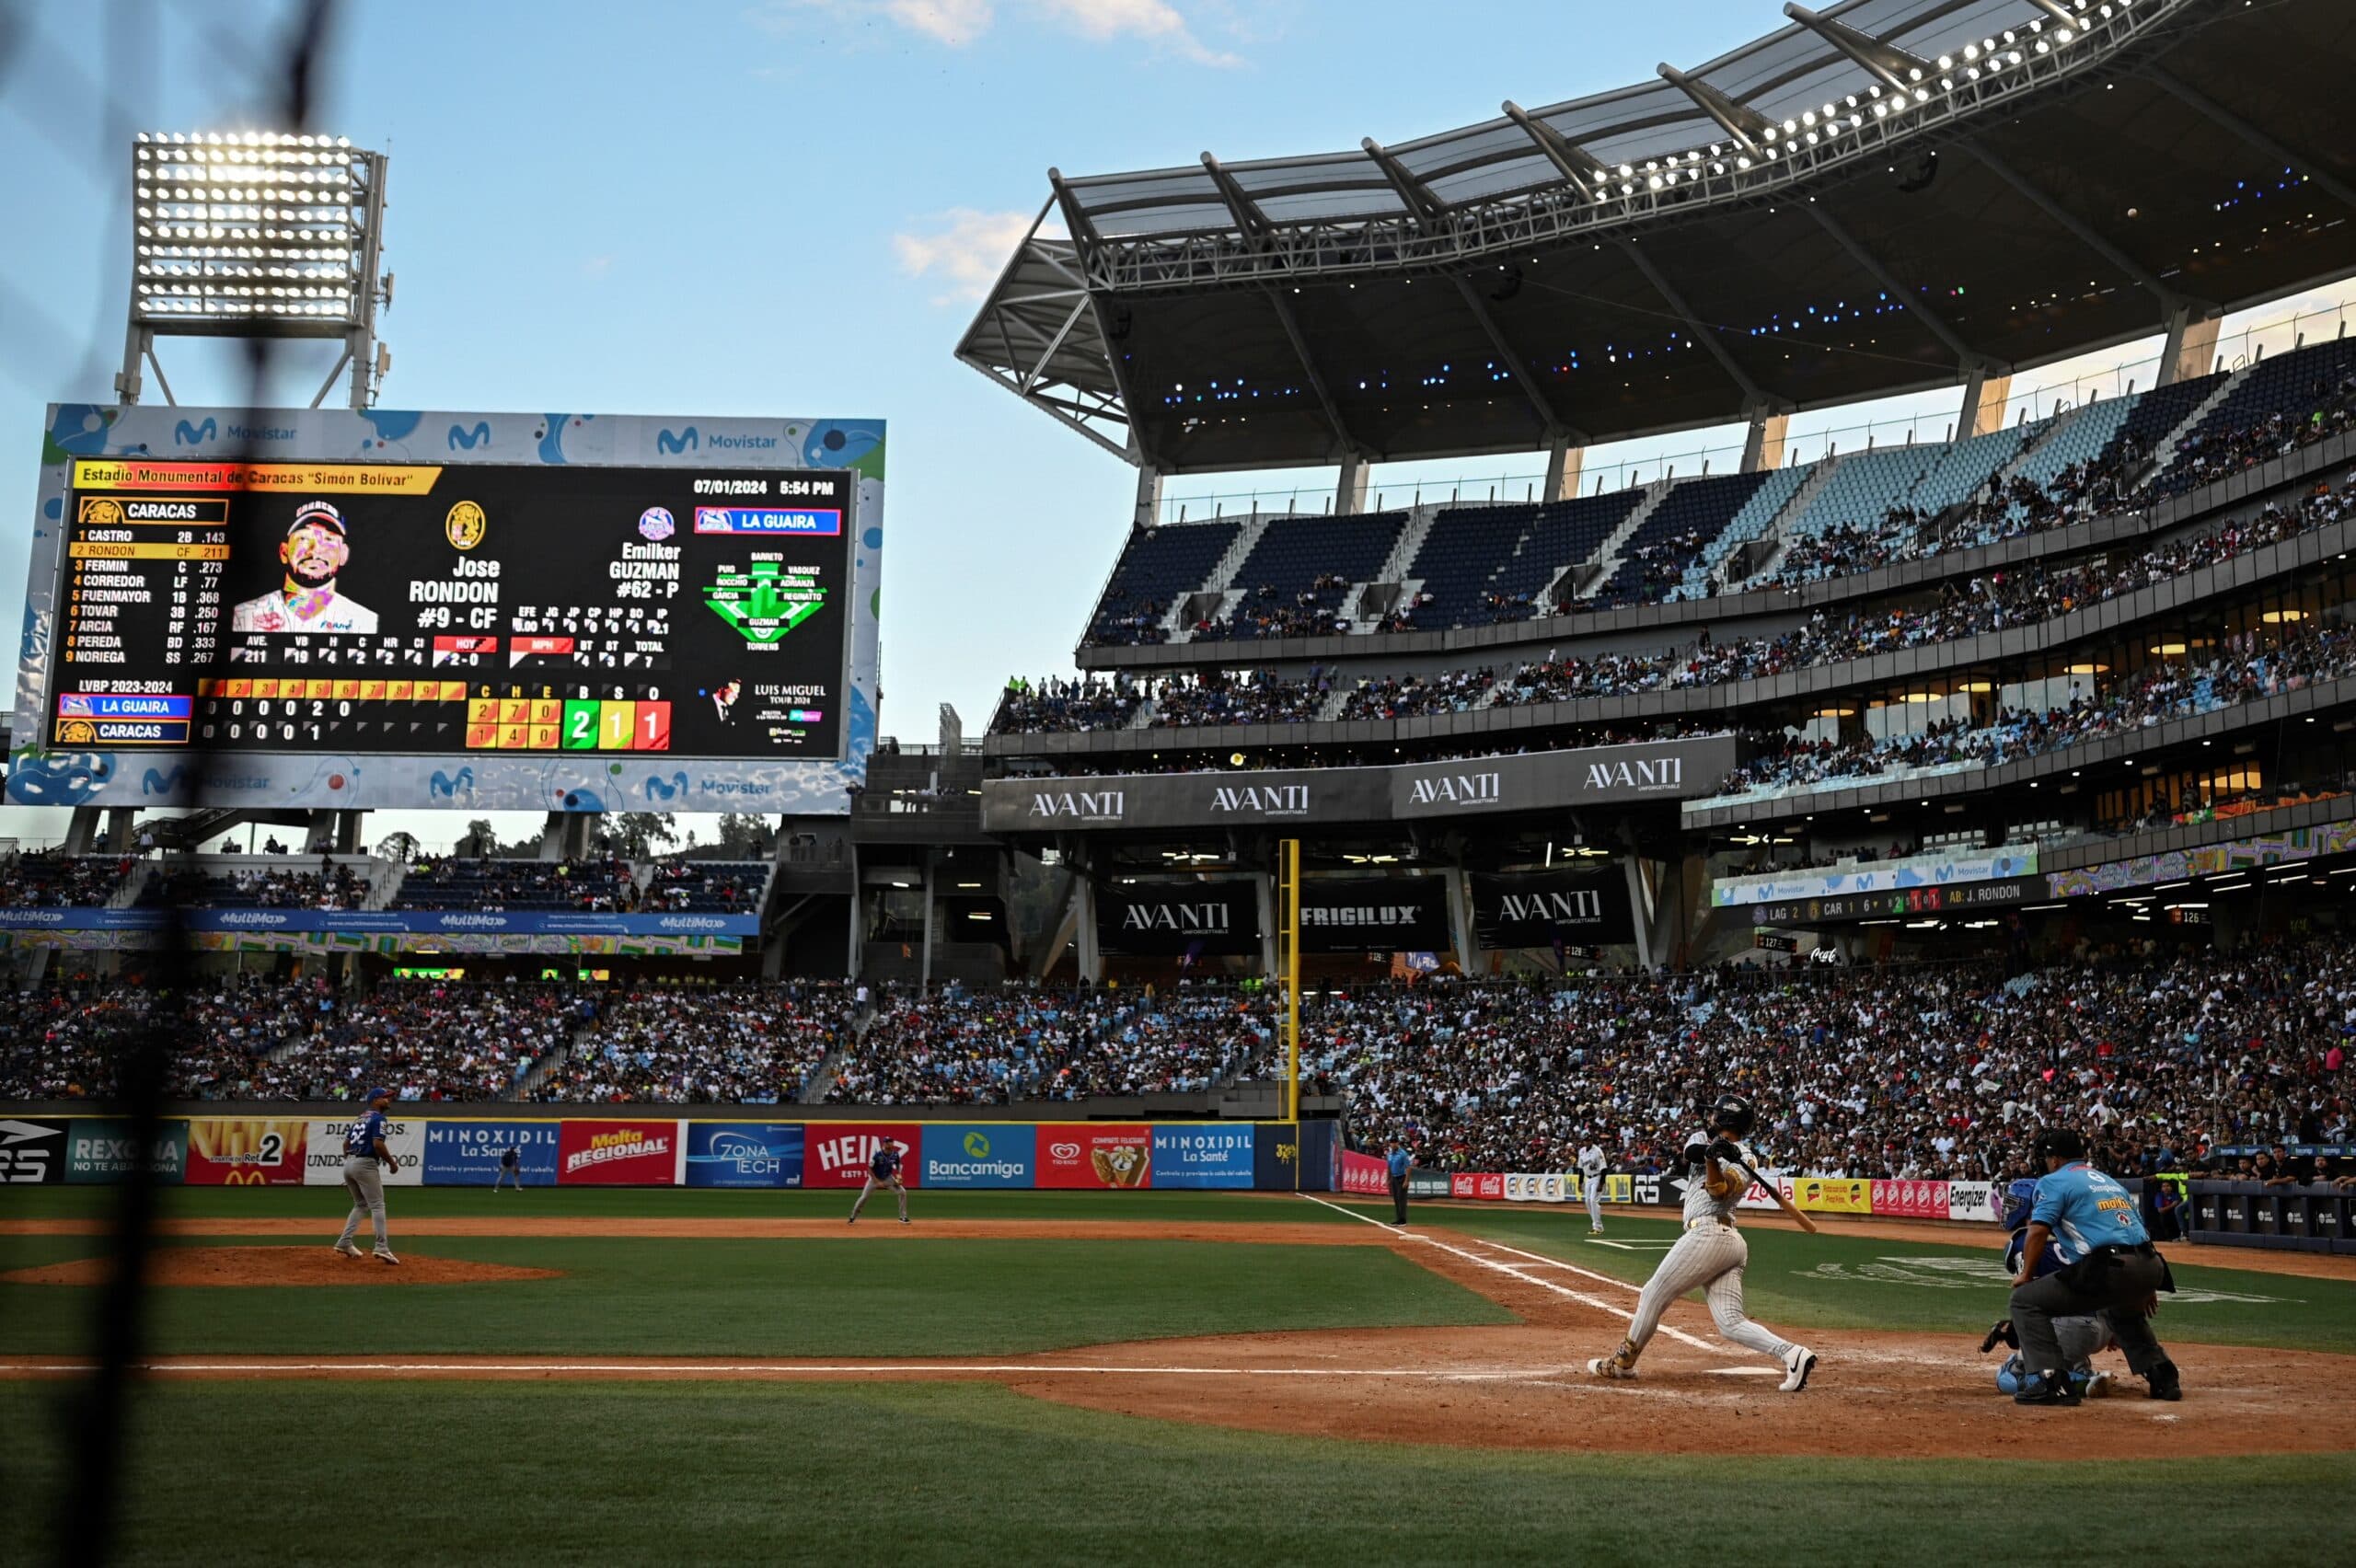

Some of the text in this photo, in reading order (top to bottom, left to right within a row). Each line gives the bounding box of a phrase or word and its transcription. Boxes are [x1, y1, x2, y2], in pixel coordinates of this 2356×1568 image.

[227, 425, 297, 441] Movistar
[709, 434, 778, 449] Movistar
[82, 467, 133, 481] Estadio
[138, 469, 223, 483] Monumental
[227, 472, 243, 484] de
[248, 471, 304, 484] Caracas
[694, 480, 834, 495] 07/01/2024 5:54 PM
[127, 503, 197, 519] CARACAS
[742, 513, 816, 529] LA GUAIRA
[88, 530, 225, 543] CASTRO 2B .143
[88, 546, 223, 558] RONDON CF .211
[622, 543, 681, 560] Emilker
[751, 552, 783, 561] BARRETO
[85, 559, 223, 573] FERMIN .273
[453, 556, 501, 578] Jose
[609, 561, 679, 580] GUZMAN
[718, 564, 735, 573] PUIG
[84, 575, 218, 588] CORREDOR LF .77
[409, 581, 499, 603] RONDON
[616, 581, 679, 598] #62 P
[81, 590, 220, 604] FUENMAYOR 1B .368
[80, 605, 218, 619] TOVAR 3B .250
[417, 606, 498, 628] #9 CF
[518, 605, 537, 617] EFE
[545, 606, 559, 617] JG
[567, 607, 581, 618] JP
[78, 620, 217, 634] ARCIA RF .167
[748, 617, 780, 626] GUZMAN
[76, 636, 215, 649] PEREDA BD .333
[246, 636, 269, 646] AVE.
[294, 636, 308, 647] VB
[383, 638, 398, 648] HR
[456, 639, 476, 650] HOY
[635, 640, 664, 652] TOTAL
[75, 651, 214, 663] NORIEGA SS .267
[78, 679, 173, 694] LVBP 2023-2024
[755, 684, 826, 697] LUIS MIGUEL
[101, 700, 169, 713] LA GUAIRA
[769, 696, 792, 705] TOUR
[99, 724, 162, 738] CARACAS
[572, 710, 590, 738] 2
[609, 711, 621, 738] 1
[643, 711, 656, 739] 1
[1583, 757, 1680, 790] AVANTI
[701, 779, 771, 795] Movistar
[1408, 772, 1499, 803] AVANTI
[1029, 791, 1124, 817] AVANTI
[1209, 785, 1309, 811] AVANTI
[1958, 866, 1989, 876] Movistar
[1777, 885, 1805, 894] Movistar
[1949, 884, 2020, 904] AB: J. RONDON
[1499, 890, 1601, 921] AVANTI
[1824, 902, 1842, 916] CAR
[223, 912, 286, 925] MultiMax
[1122, 902, 1229, 929] AVANTI
[1300, 905, 1416, 926] FRIGILUX
[1770, 907, 1786, 920] LAG
[2184, 912, 2200, 923] 126
[443, 915, 506, 928] MultiMax
[663, 917, 725, 928] MultiMax
[1765, 937, 1777, 948] 127
[429, 1129, 556, 1144] MINOXIDIL
[591, 1129, 643, 1149] Malta
[1155, 1136, 1252, 1149] MINOXIDIL
[261, 1135, 280, 1162] 2
[461, 1144, 522, 1158] La Sané
[567, 1138, 666, 1169] REGIONAL
[721, 1144, 769, 1159] ZONA
[1184, 1149, 1229, 1162] La Santé
[74, 1161, 178, 1172] NO TE ABAONA
[736, 1159, 780, 1174] TECH
[929, 1159, 1024, 1178] Bancamiga
[1950, 1186, 1987, 1212] Energizer
